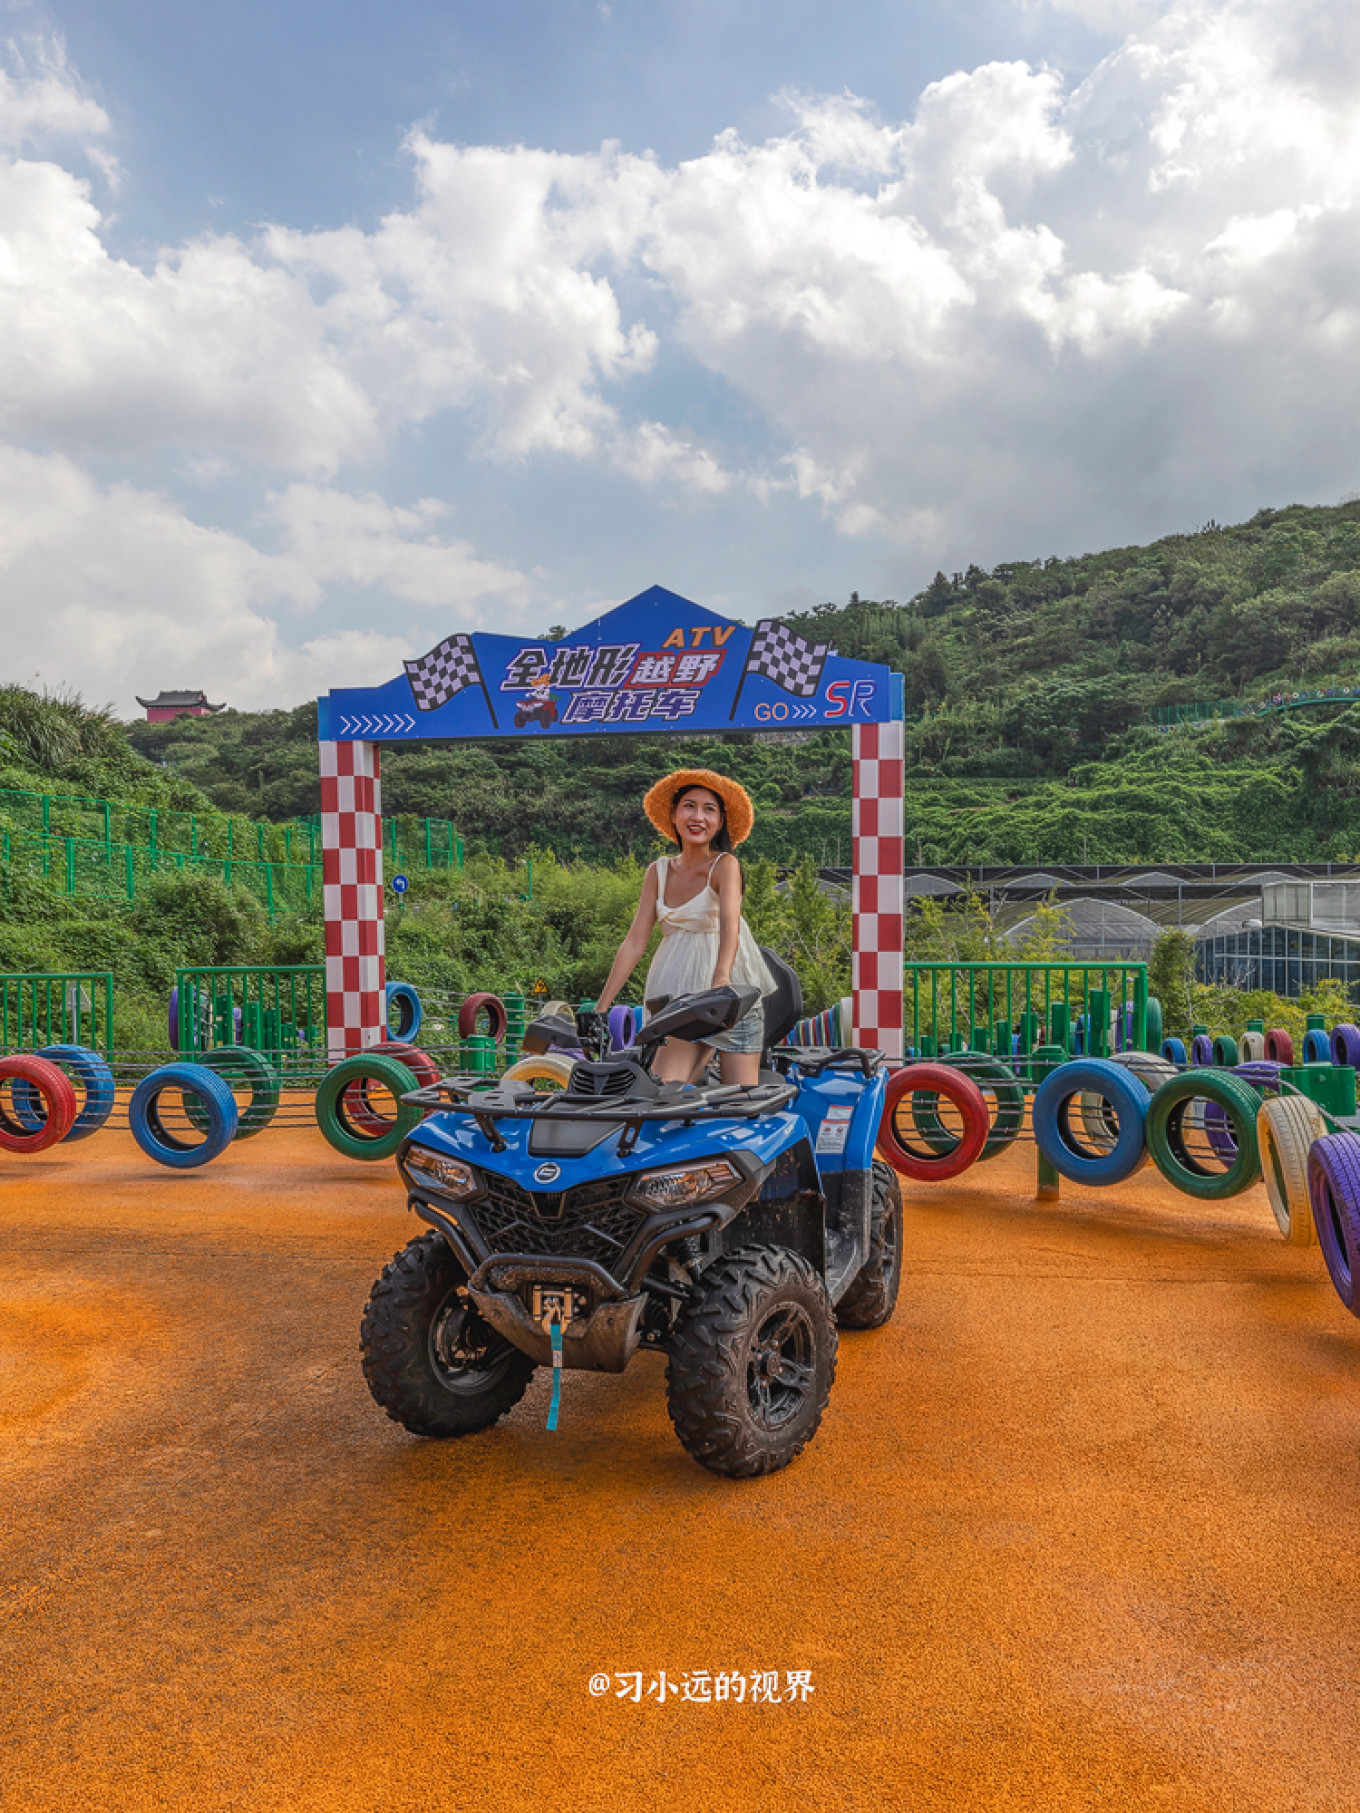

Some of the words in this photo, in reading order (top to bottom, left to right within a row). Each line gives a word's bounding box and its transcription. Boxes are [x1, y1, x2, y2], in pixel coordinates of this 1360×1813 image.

[660, 625, 736, 649] ATV
[561, 688, 701, 723] 摩托车
[754, 702, 789, 721] GO
[824, 680, 877, 718] SR
